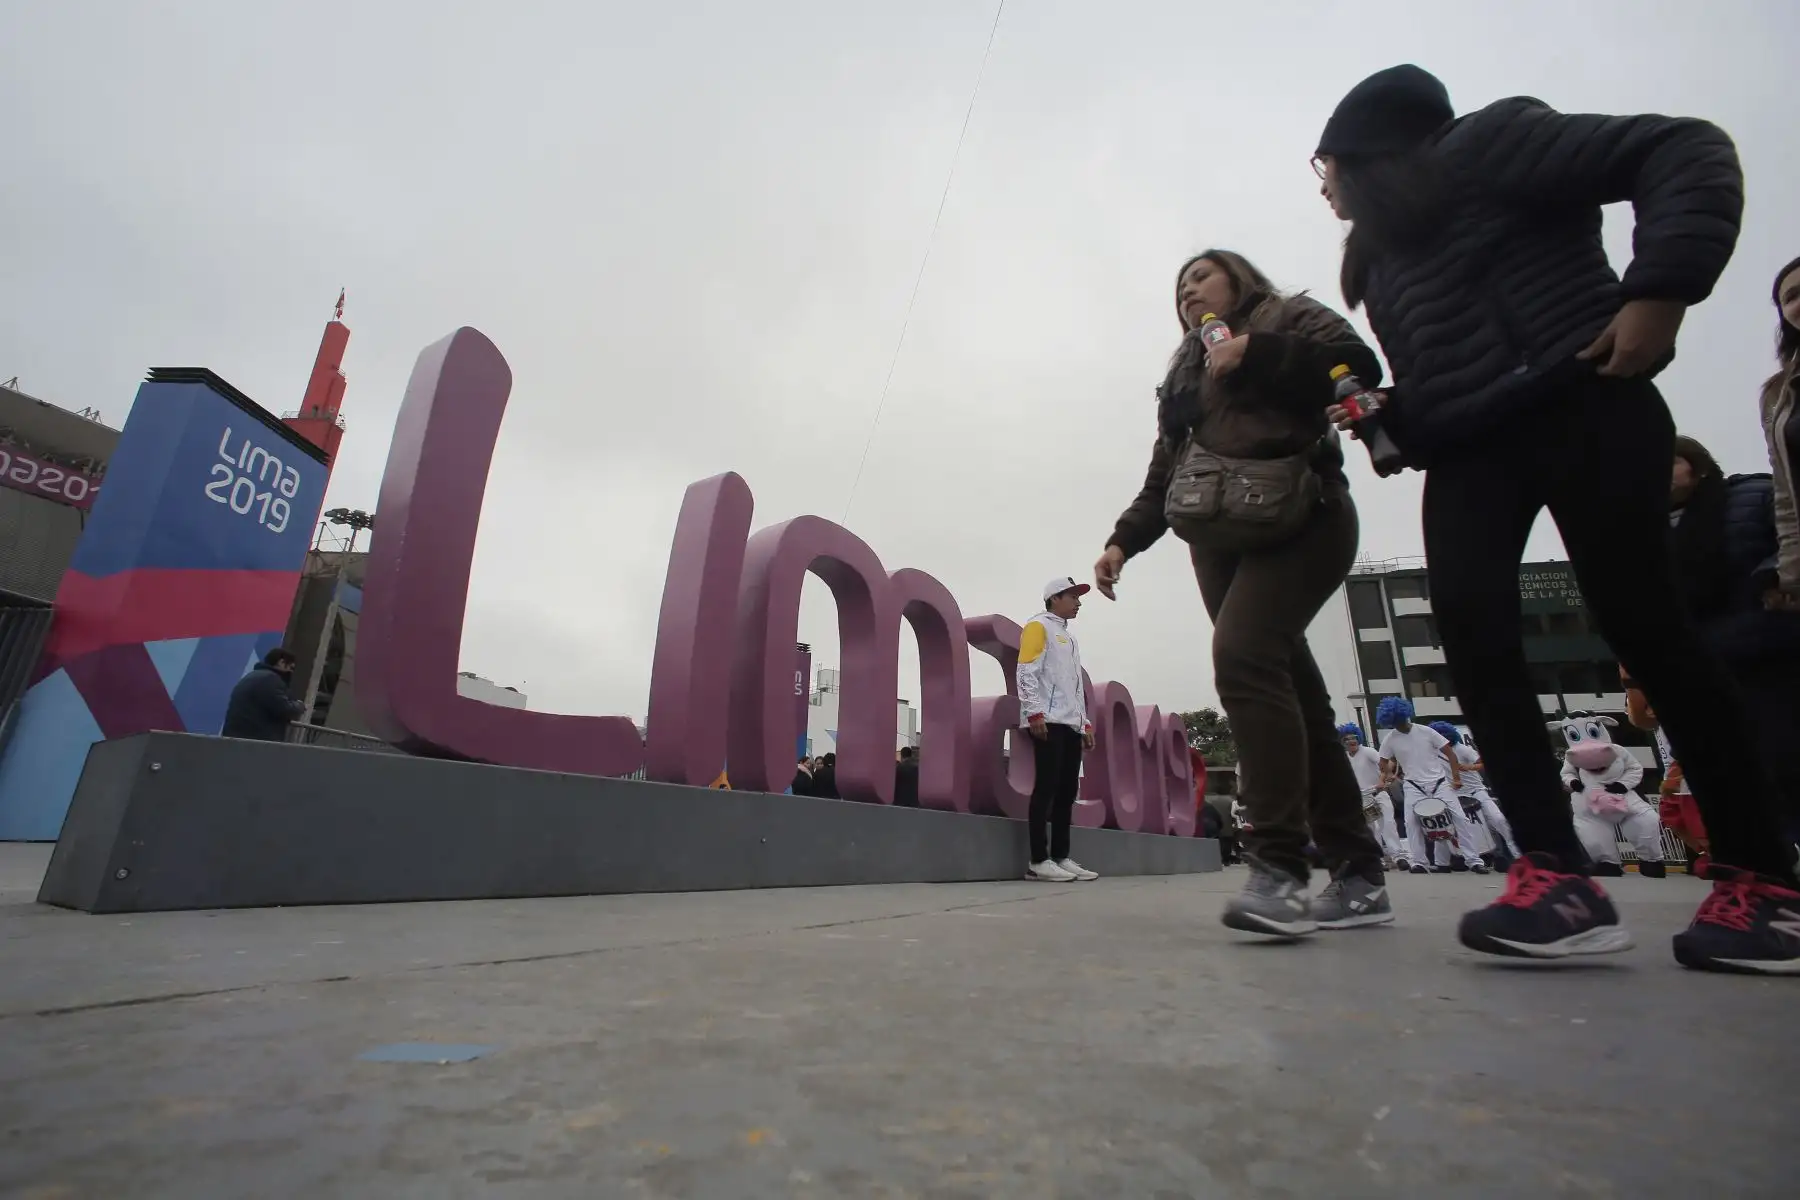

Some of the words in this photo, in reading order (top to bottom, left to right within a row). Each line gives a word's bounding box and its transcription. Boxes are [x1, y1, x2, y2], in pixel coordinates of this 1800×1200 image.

[0, 450, 101, 500] a20
[205, 464, 290, 533] 2019
[1519, 572, 1568, 581] CIACION
[1521, 591, 1536, 599] DE
[1539, 590, 1554, 599] LA
[1422, 808, 1453, 830] ORI
